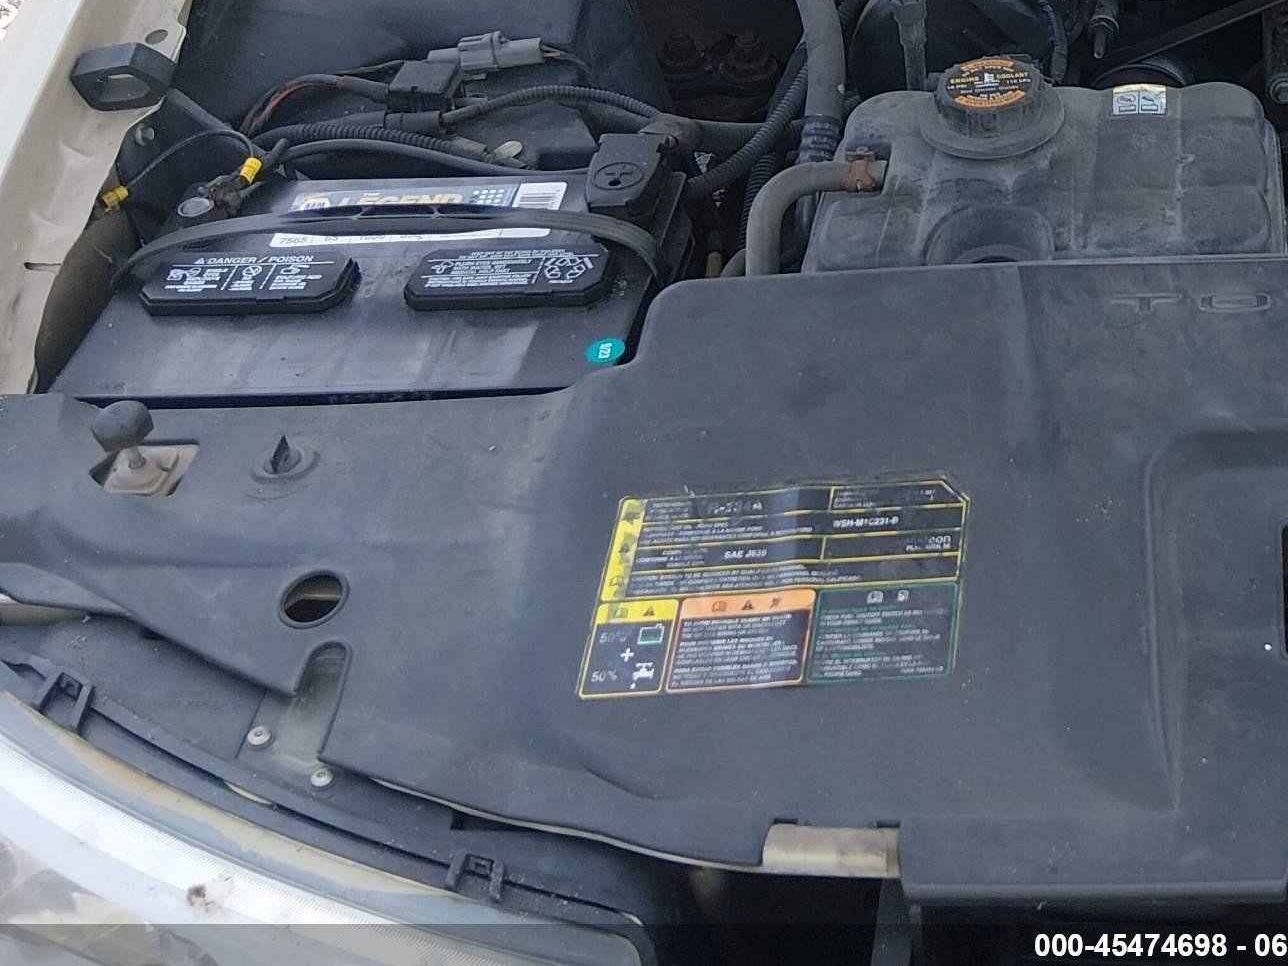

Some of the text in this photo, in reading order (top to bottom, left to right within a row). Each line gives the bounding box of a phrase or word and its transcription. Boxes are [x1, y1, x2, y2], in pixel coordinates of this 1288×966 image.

[996, 72, 1029, 80] COOLANT
[269, 255, 315, 263] POISON
[724, 550, 744, 559] SAE
[591, 669, 618, 683] 50%
